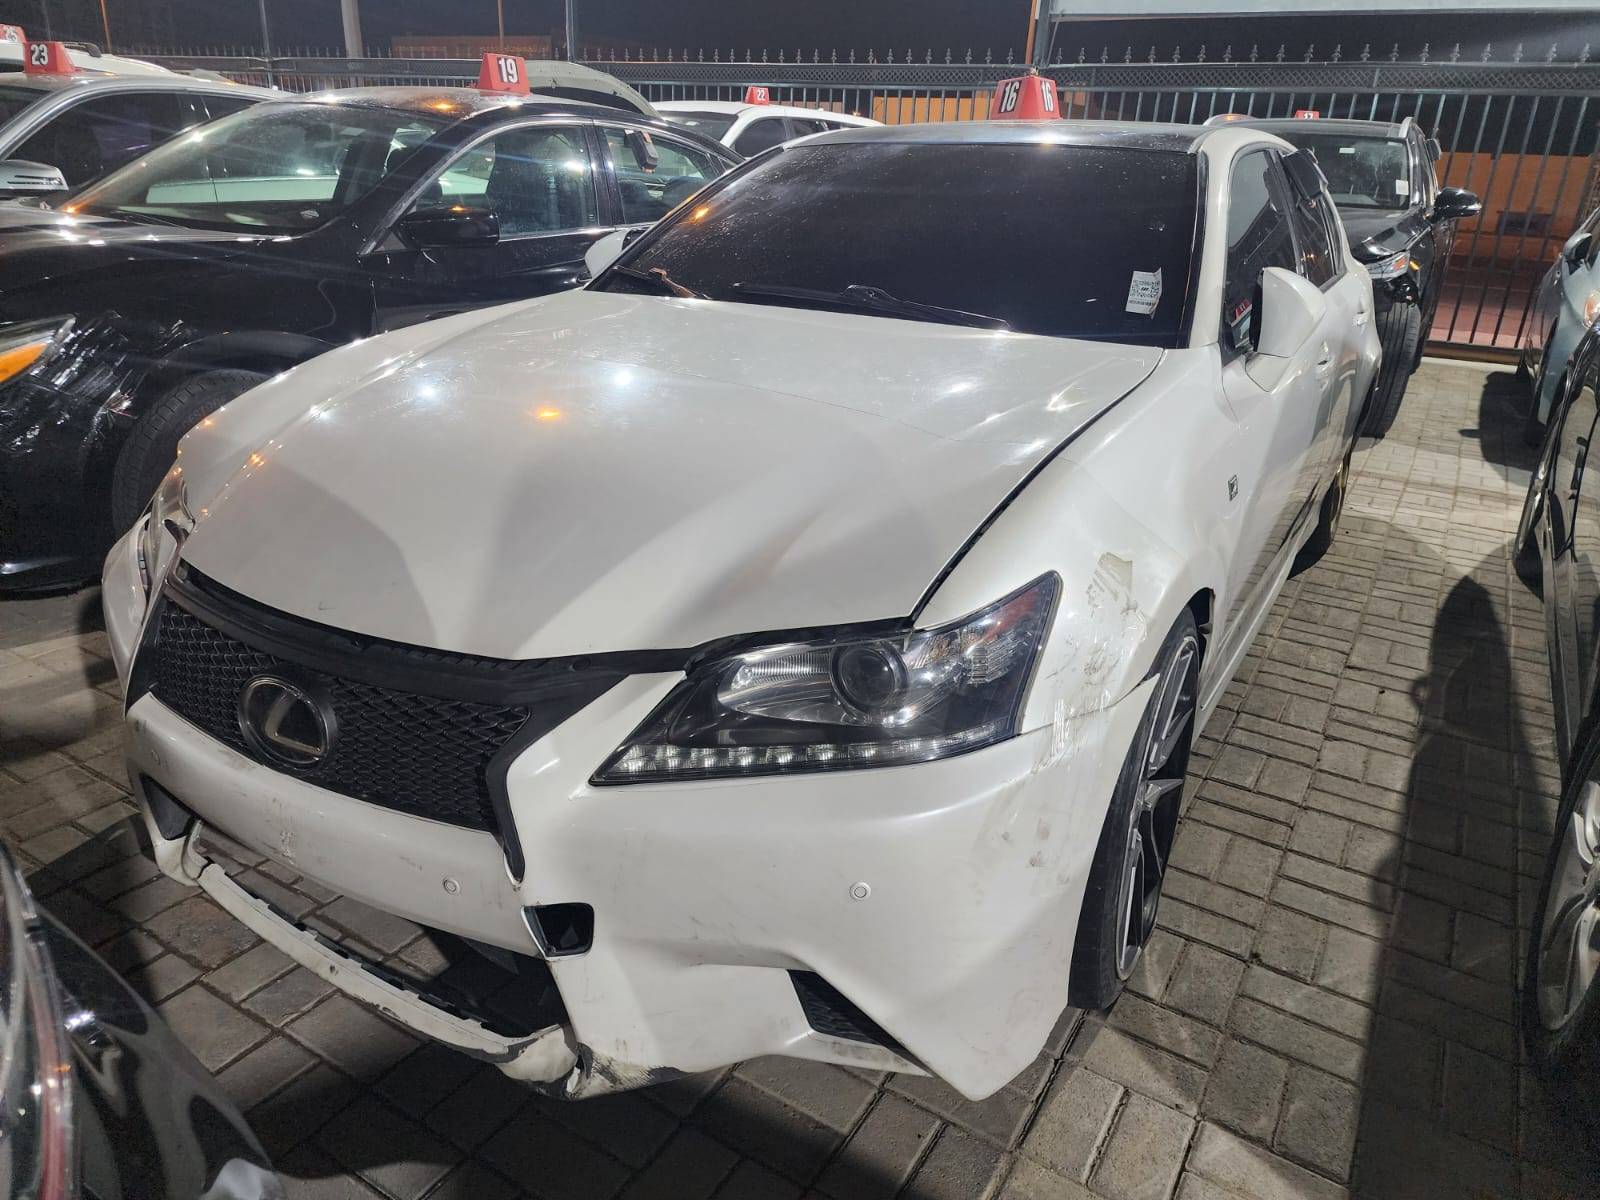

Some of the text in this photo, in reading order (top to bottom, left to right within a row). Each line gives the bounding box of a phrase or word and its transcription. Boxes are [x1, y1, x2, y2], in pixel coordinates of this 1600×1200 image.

[31, 44, 49, 66] 23
[498, 57, 519, 84] 19
[1000, 80, 1020, 113] 16
[1041, 80, 1054, 112] 16
